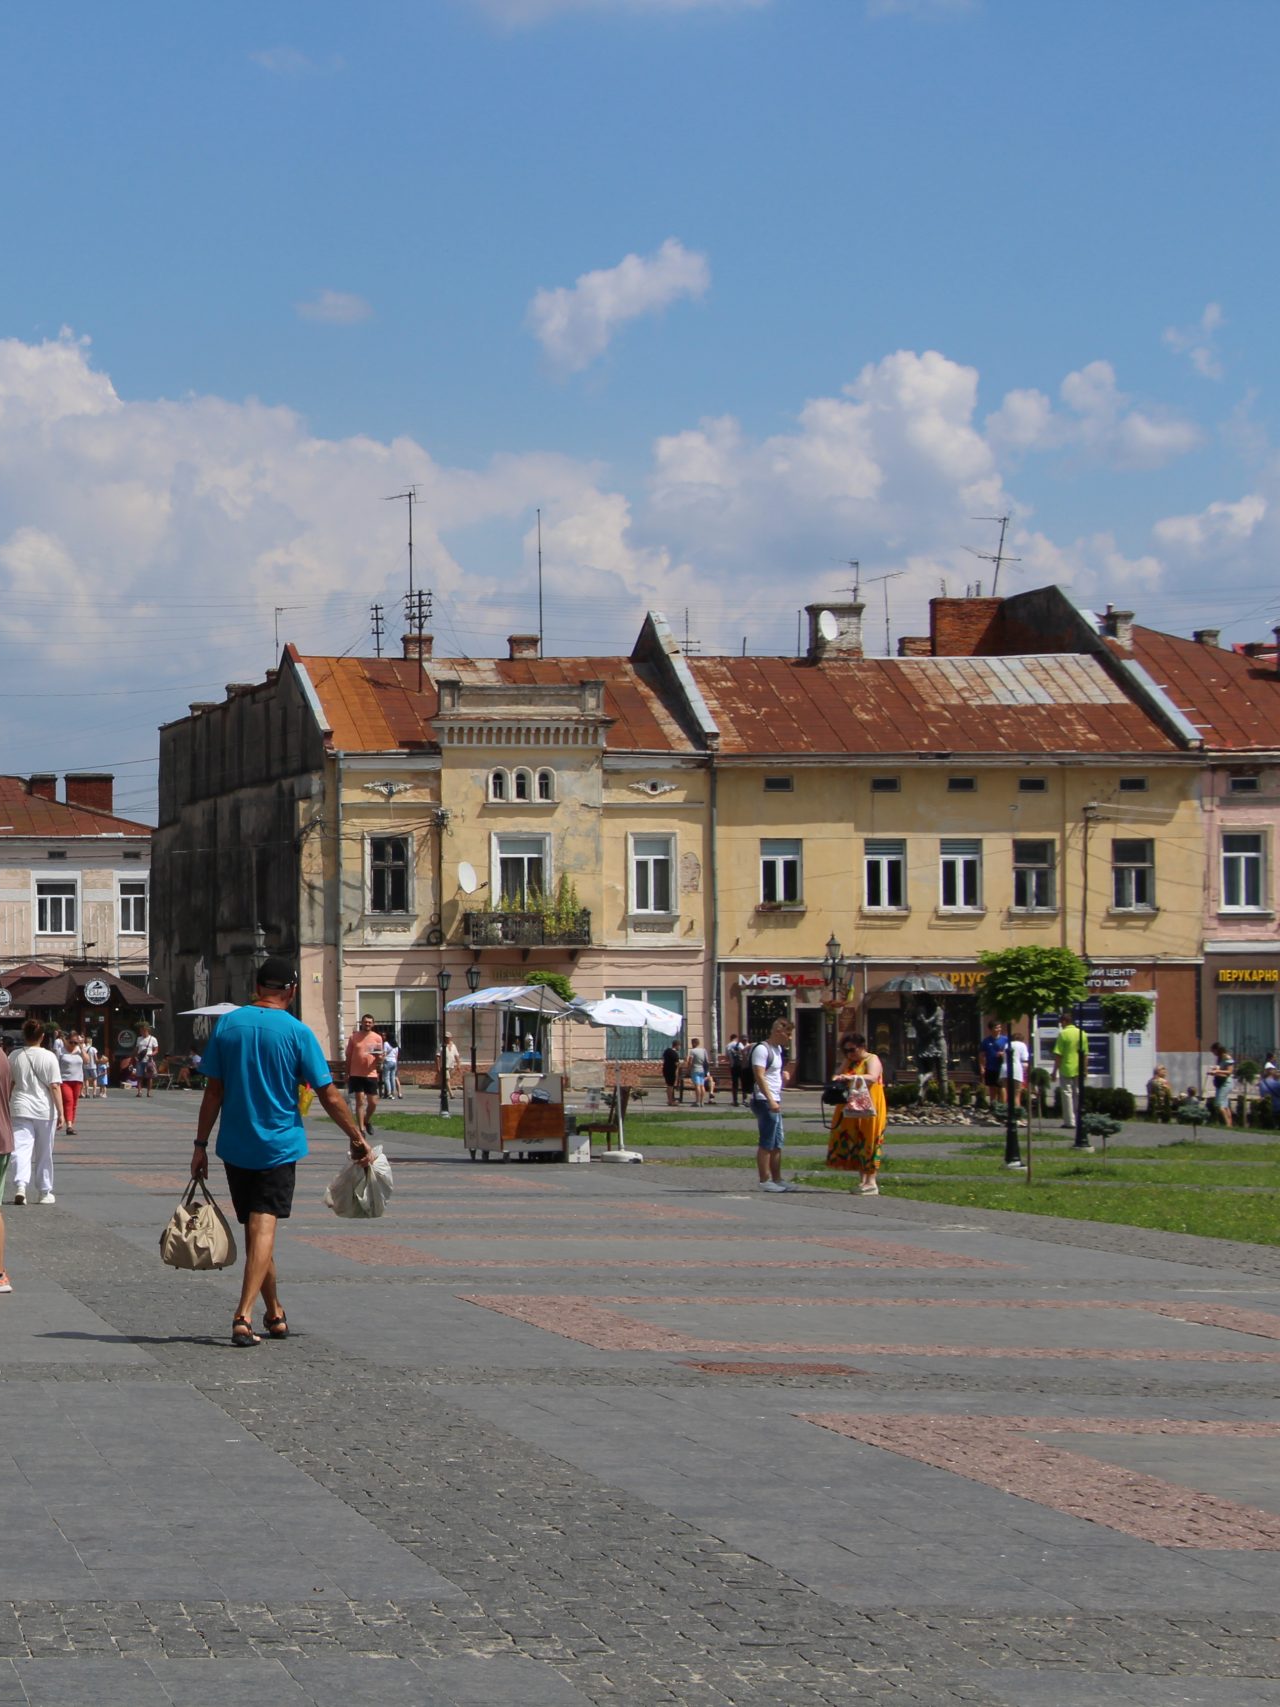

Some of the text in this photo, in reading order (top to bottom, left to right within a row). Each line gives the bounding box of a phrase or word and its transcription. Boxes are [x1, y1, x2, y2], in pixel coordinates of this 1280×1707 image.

[1106, 968, 1137, 977] ЦЕНТР
[1218, 969, 1279, 982] ПЕРУКАРНЯ
[1103, 979, 1131, 987] МІСТА
